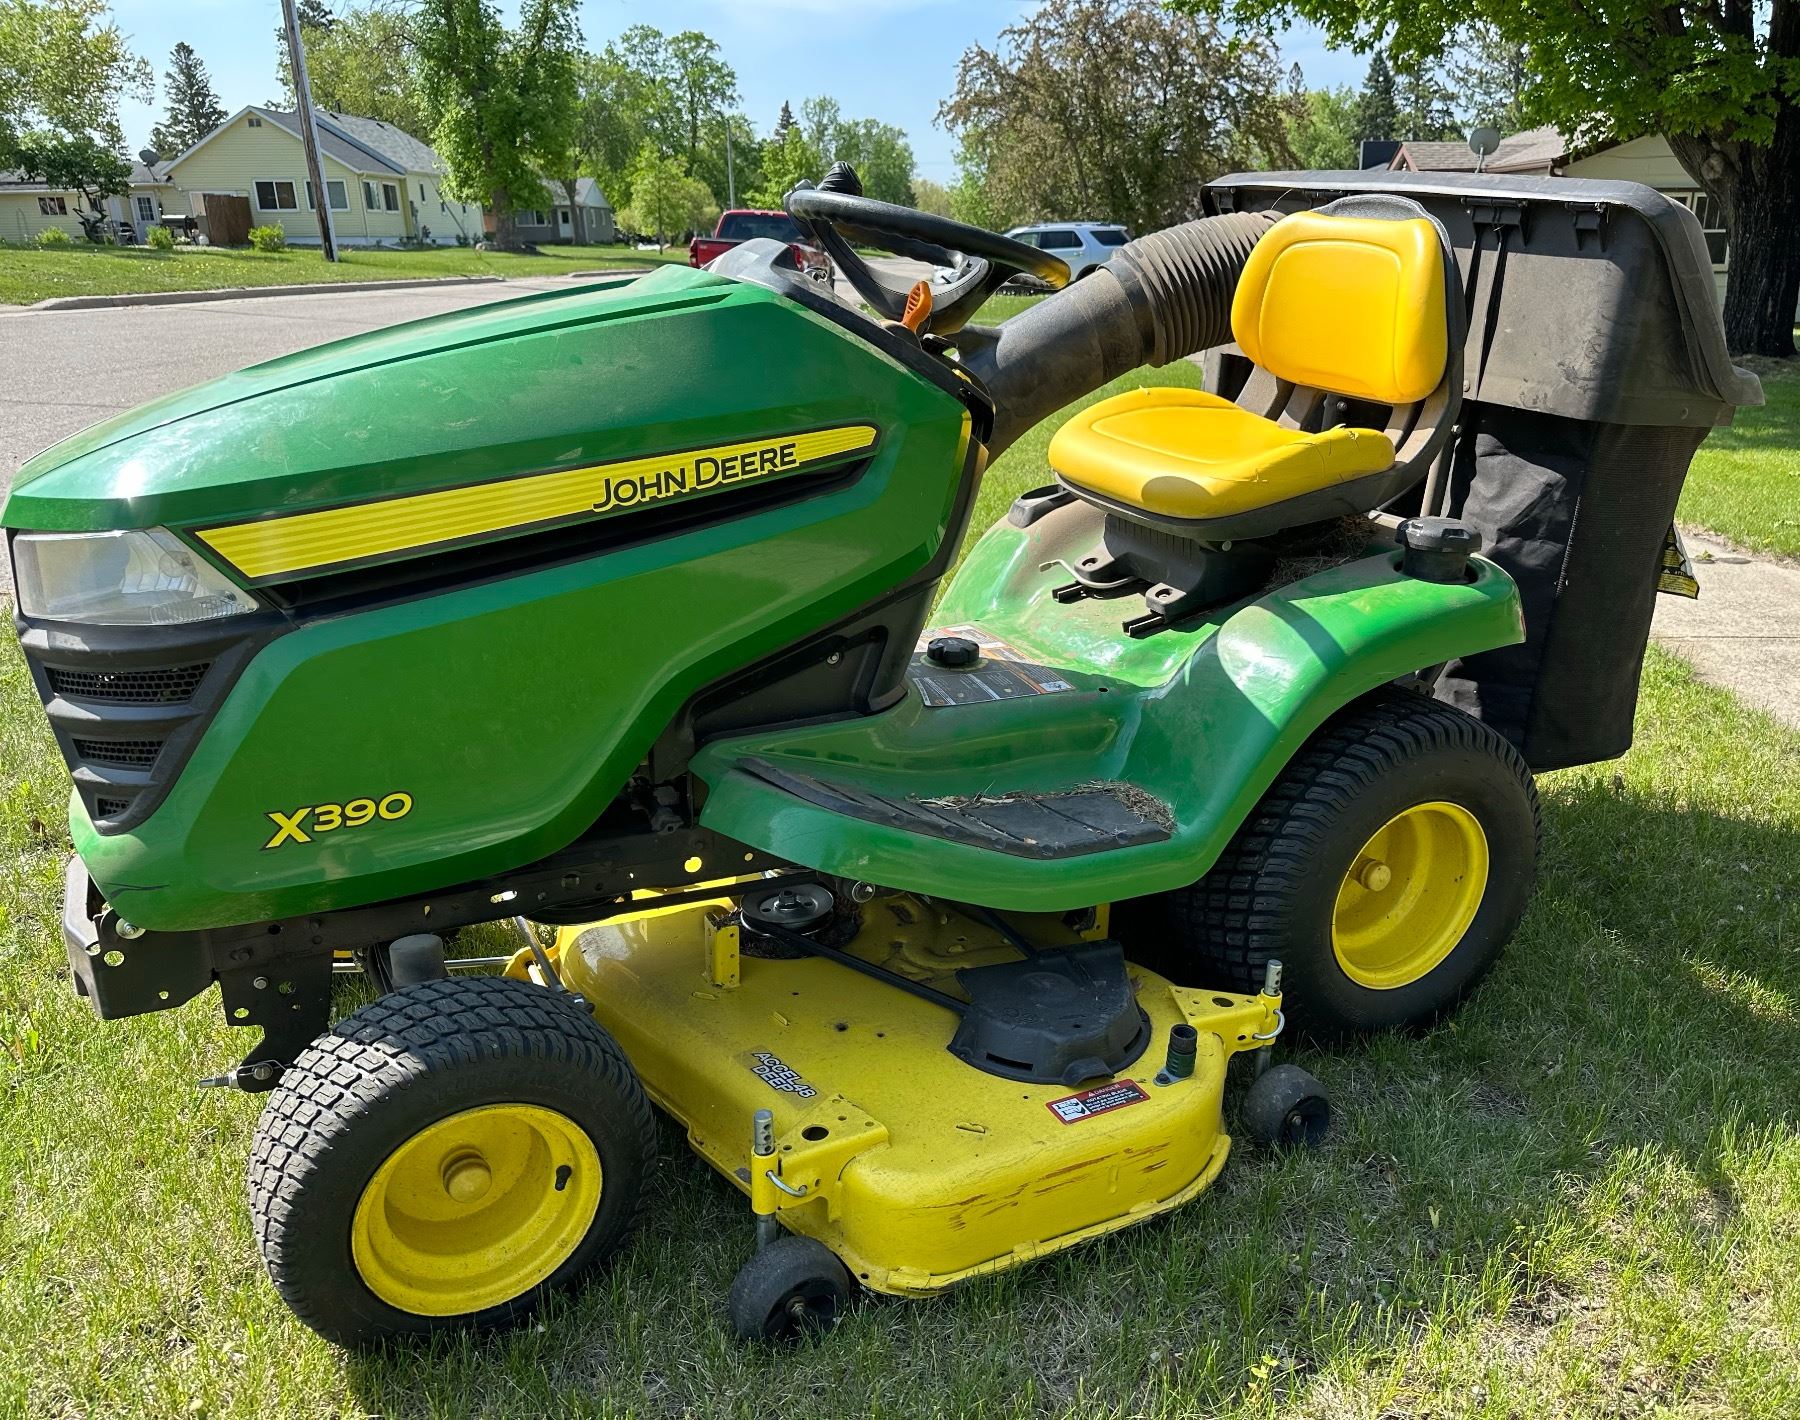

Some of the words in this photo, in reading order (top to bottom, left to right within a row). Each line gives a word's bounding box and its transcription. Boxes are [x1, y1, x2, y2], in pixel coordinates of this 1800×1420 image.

[592, 467, 687, 511] JOHN
[694, 443, 798, 488] DEERE
[262, 791, 414, 850] X390
[750, 1065, 795, 1092] DEEP
[751, 1053, 802, 1086] ACCEL
[1094, 1083, 1121, 1095] DANGER
